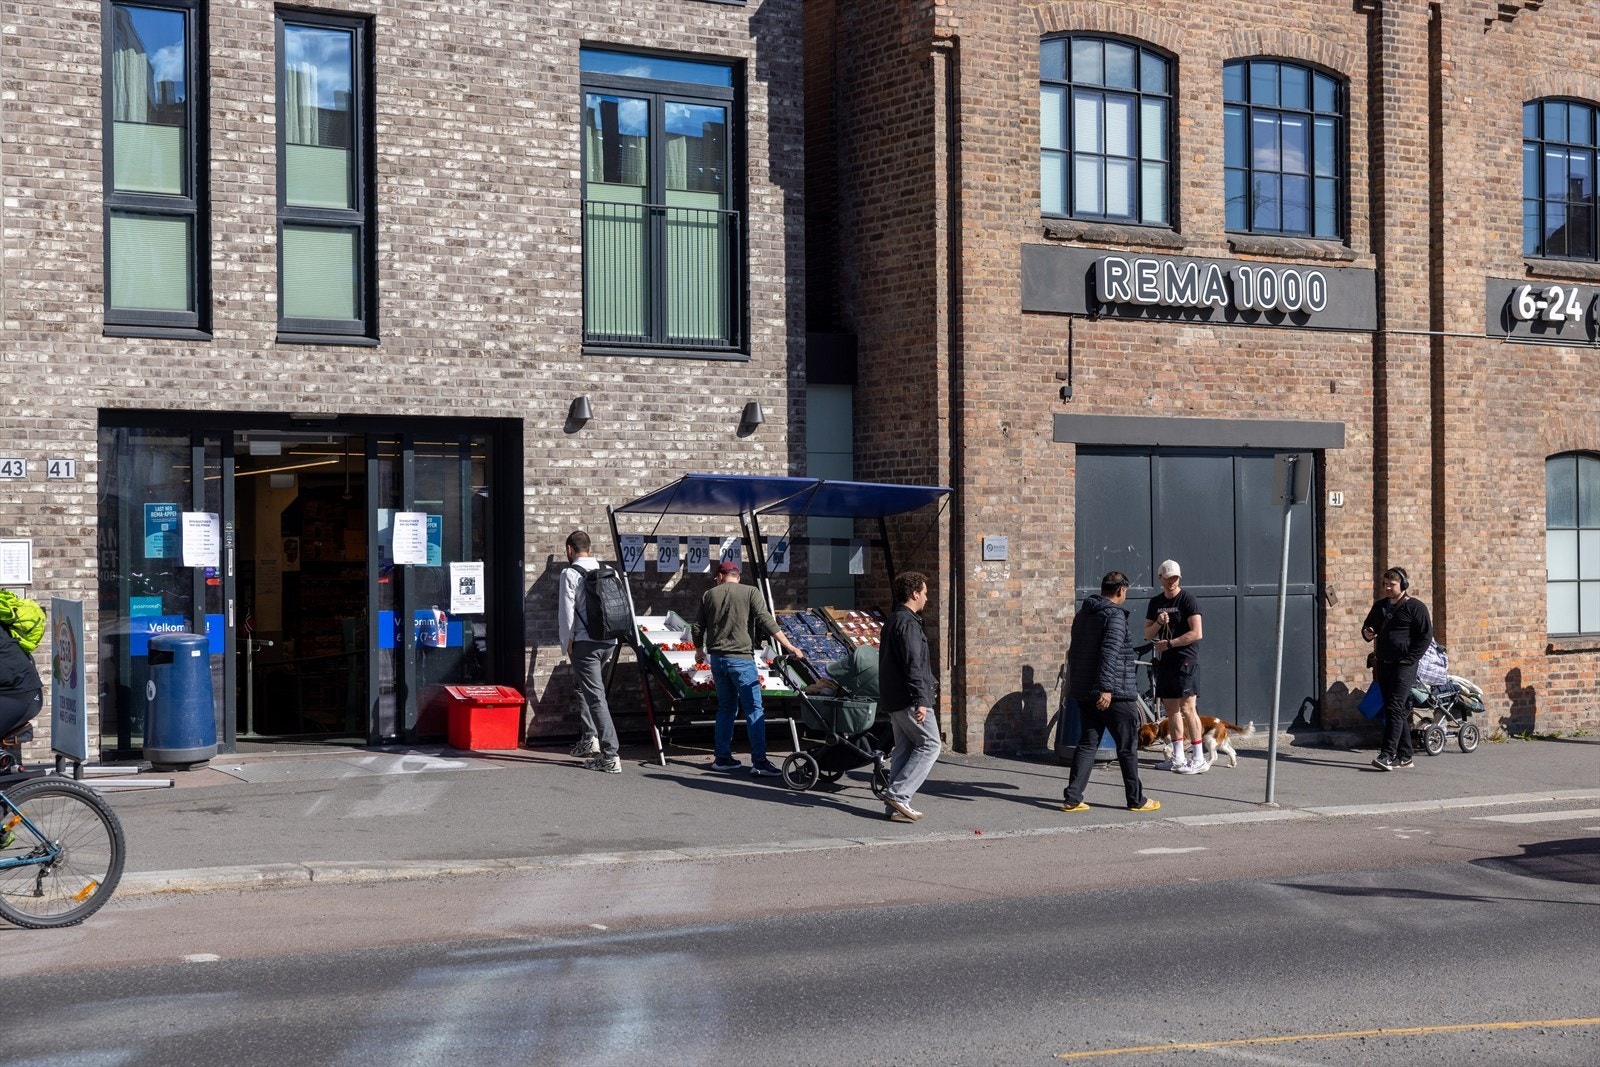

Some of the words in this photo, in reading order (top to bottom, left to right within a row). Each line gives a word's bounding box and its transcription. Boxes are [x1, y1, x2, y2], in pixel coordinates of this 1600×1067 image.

[1103, 256, 1229, 306] REMA
[1238, 266, 1328, 312] 1000
[1518, 284, 1583, 321] 6-24
[1, 460, 23, 476] 43
[49, 461, 71, 477] 41
[1331, 492, 1341, 505] 41
[623, 546, 636, 562] 29
[660, 547, 672, 563] 29
[690, 547, 702, 563] 29
